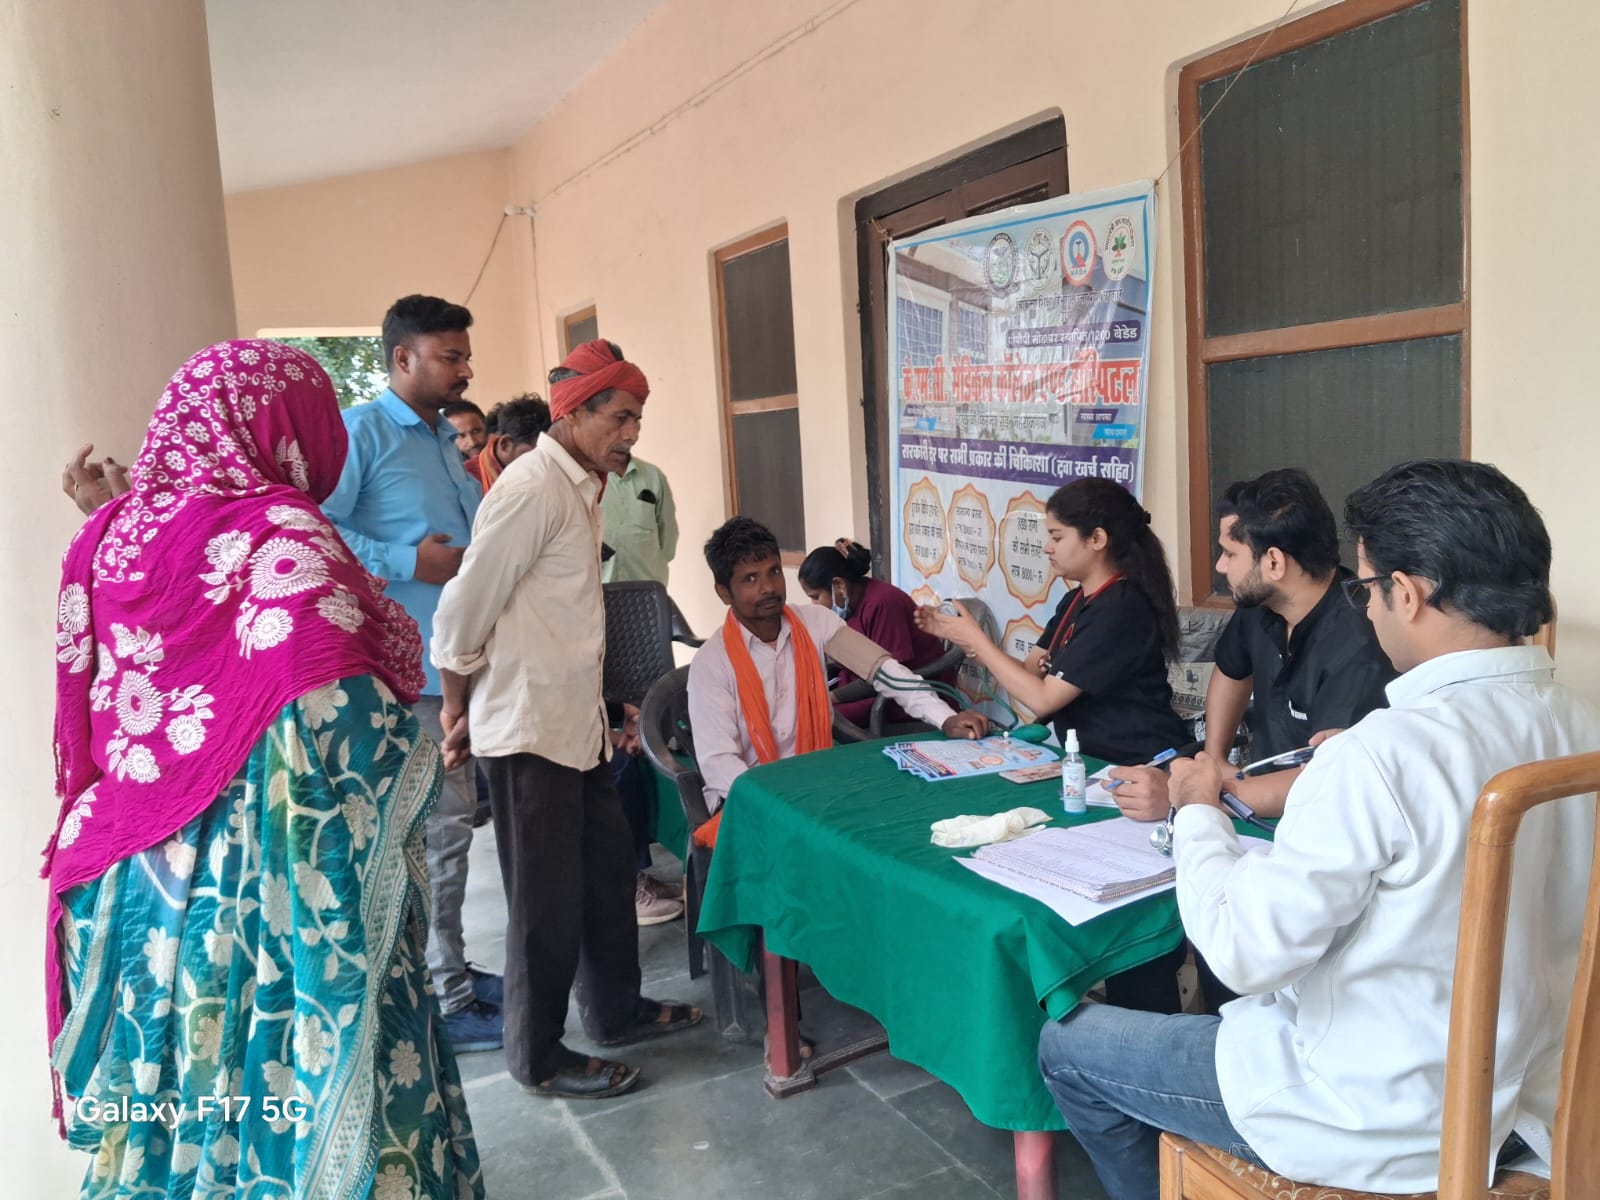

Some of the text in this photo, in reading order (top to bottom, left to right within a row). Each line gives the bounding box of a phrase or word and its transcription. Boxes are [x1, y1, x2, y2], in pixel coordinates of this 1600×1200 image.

[1113, 324, 1138, 340] बेडेड
[951, 353, 993, 402] मेडिकल
[1069, 346, 1140, 405] हॉस्पिटल
[938, 449, 948, 463] पर
[950, 443, 967, 465] सभी
[968, 450, 992, 467] प्रकार
[993, 445, 1007, 469] की
[1008, 446, 1049, 473] चिकित्सा
[1074, 455, 1097, 478] खर्च
